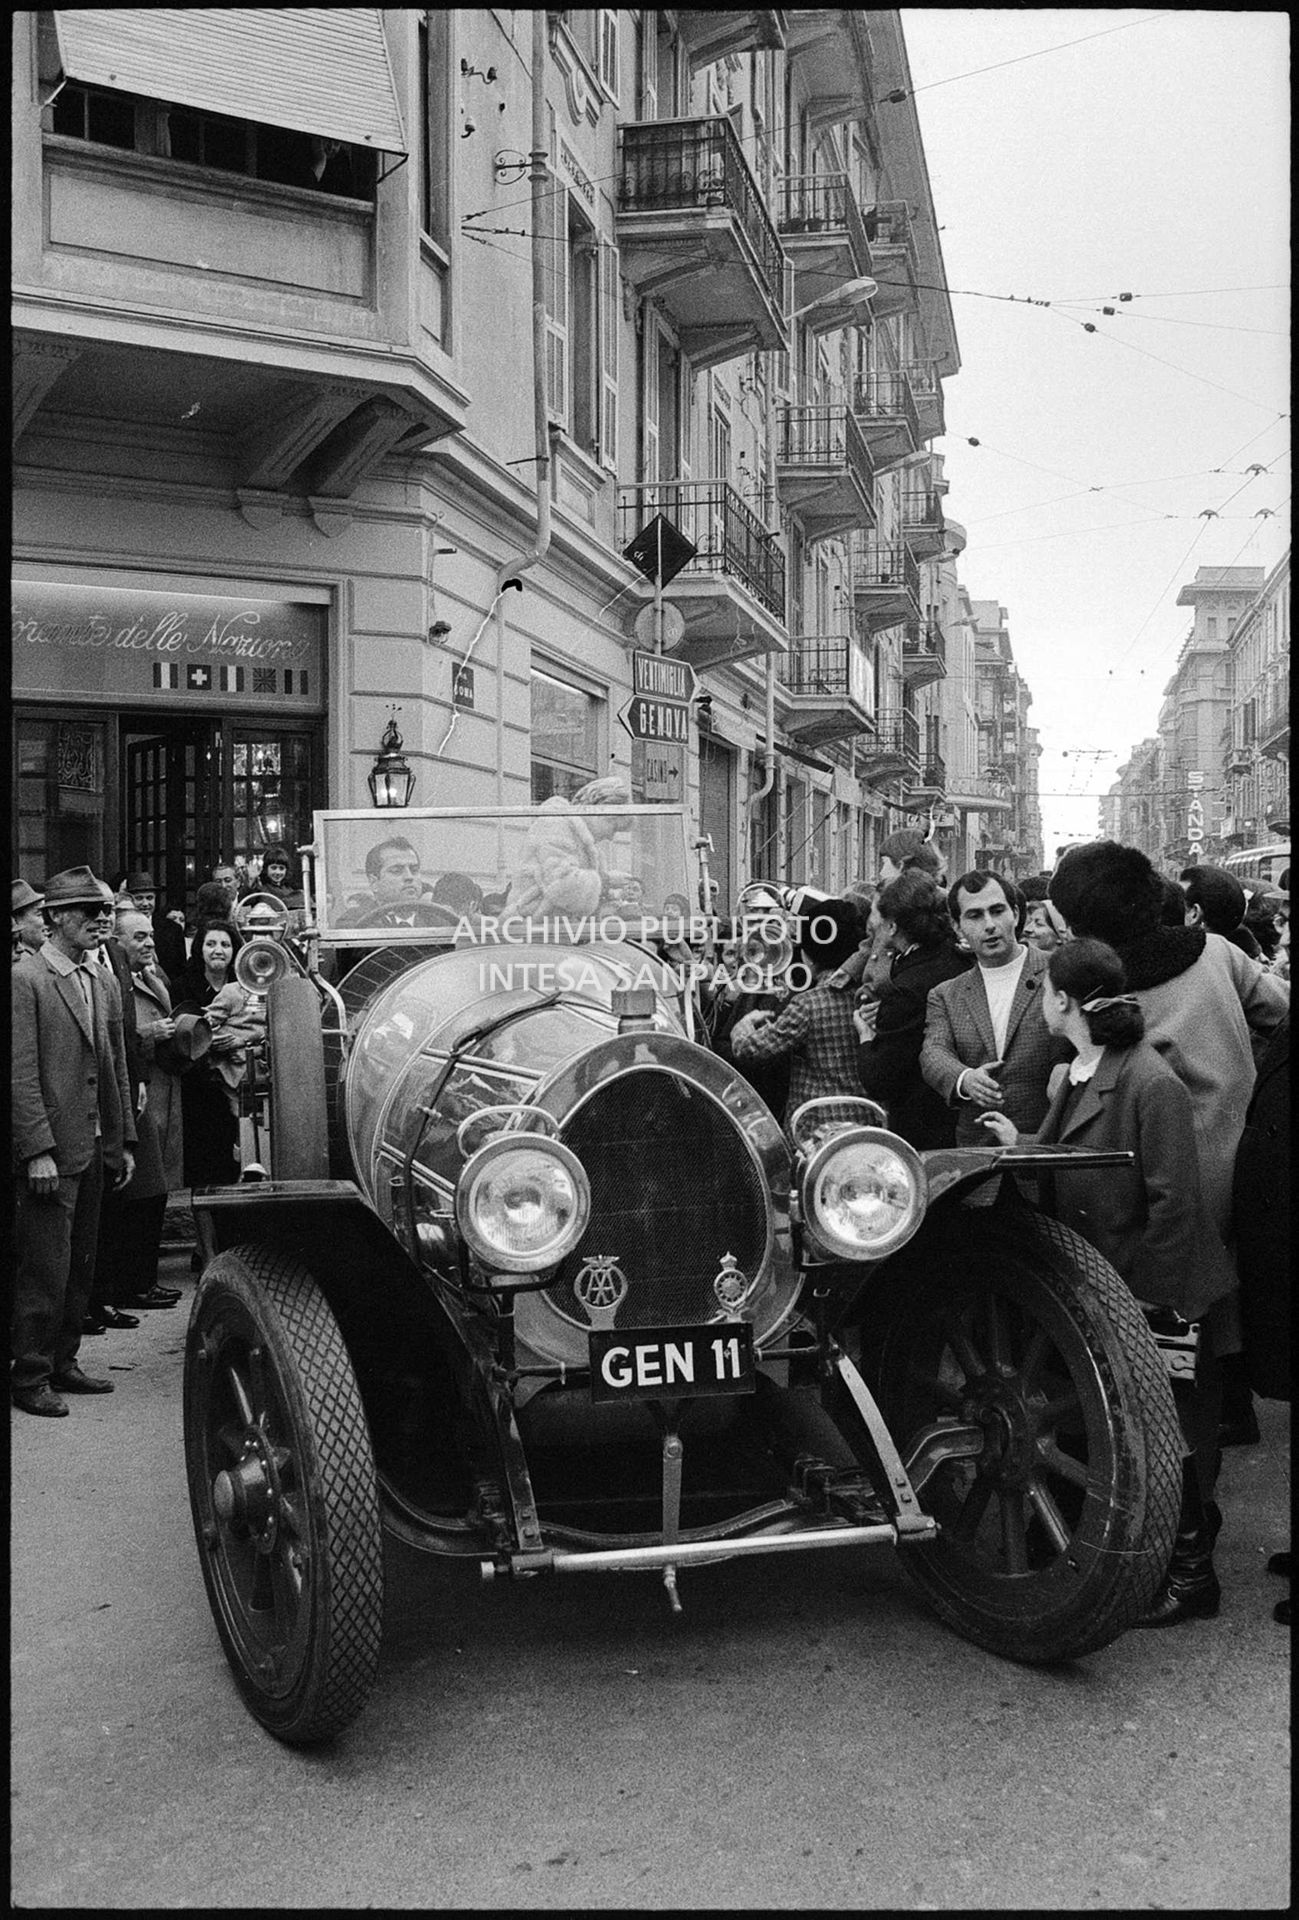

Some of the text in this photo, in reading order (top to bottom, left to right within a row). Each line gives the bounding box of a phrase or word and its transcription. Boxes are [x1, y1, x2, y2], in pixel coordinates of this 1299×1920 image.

[115, 612, 188, 651] delle
[187, 611, 310, 658] Nazioni
[637, 657, 686, 698] VENTIMIGLIA
[639, 702, 688, 740] GENOVA
[1187, 771, 1204, 855] STANDA
[601, 1338, 741, 1387] GEN 11
